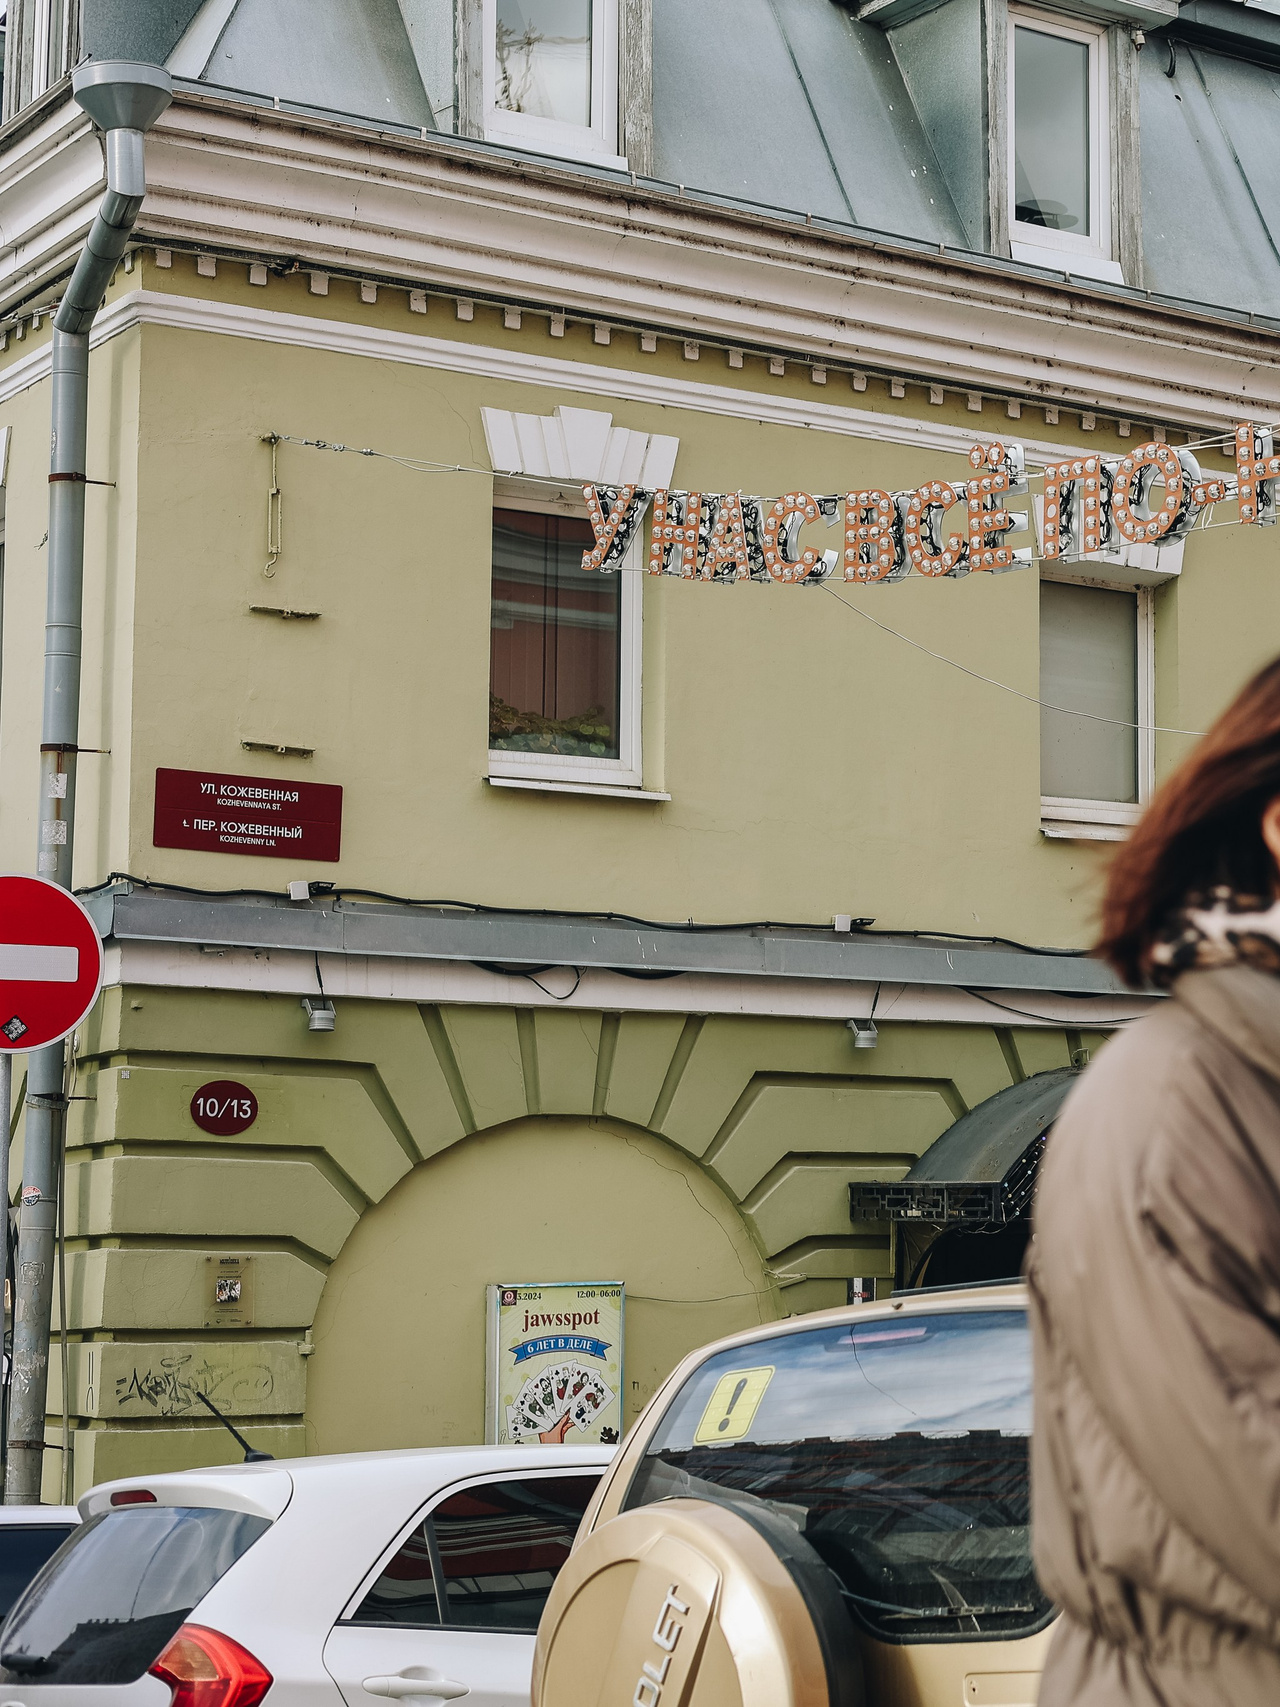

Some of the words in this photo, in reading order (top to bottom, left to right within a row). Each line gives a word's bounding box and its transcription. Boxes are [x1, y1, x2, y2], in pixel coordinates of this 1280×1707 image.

[581, 484, 637, 570] У
[649, 488, 821, 583] НАС
[843, 441, 1014, 583] ВСЁ
[200, 782, 218, 795] УЛ.
[220, 784, 299, 803] КОЖЕВЕННАЯ
[217, 798, 271, 809] KOZHEVENNAYA
[272, 802, 282, 811] ST.
[193, 818, 218, 832] ПЕР.
[220, 821, 302, 839] КОЖЕВЕННЫЙ
[219, 835, 265, 845] KOZHEVENNY
[265, 838, 276, 847] LN.
[196, 1097, 252, 1119] 10/13
[522, 1308, 600, 1333] jawsspot
[527, 1344, 534, 1354] 6
[536, 1340, 556, 1351] ЛЕТ
[558, 1339, 565, 1349] В
[566, 1340, 593, 1351] ДЕЛЕ
